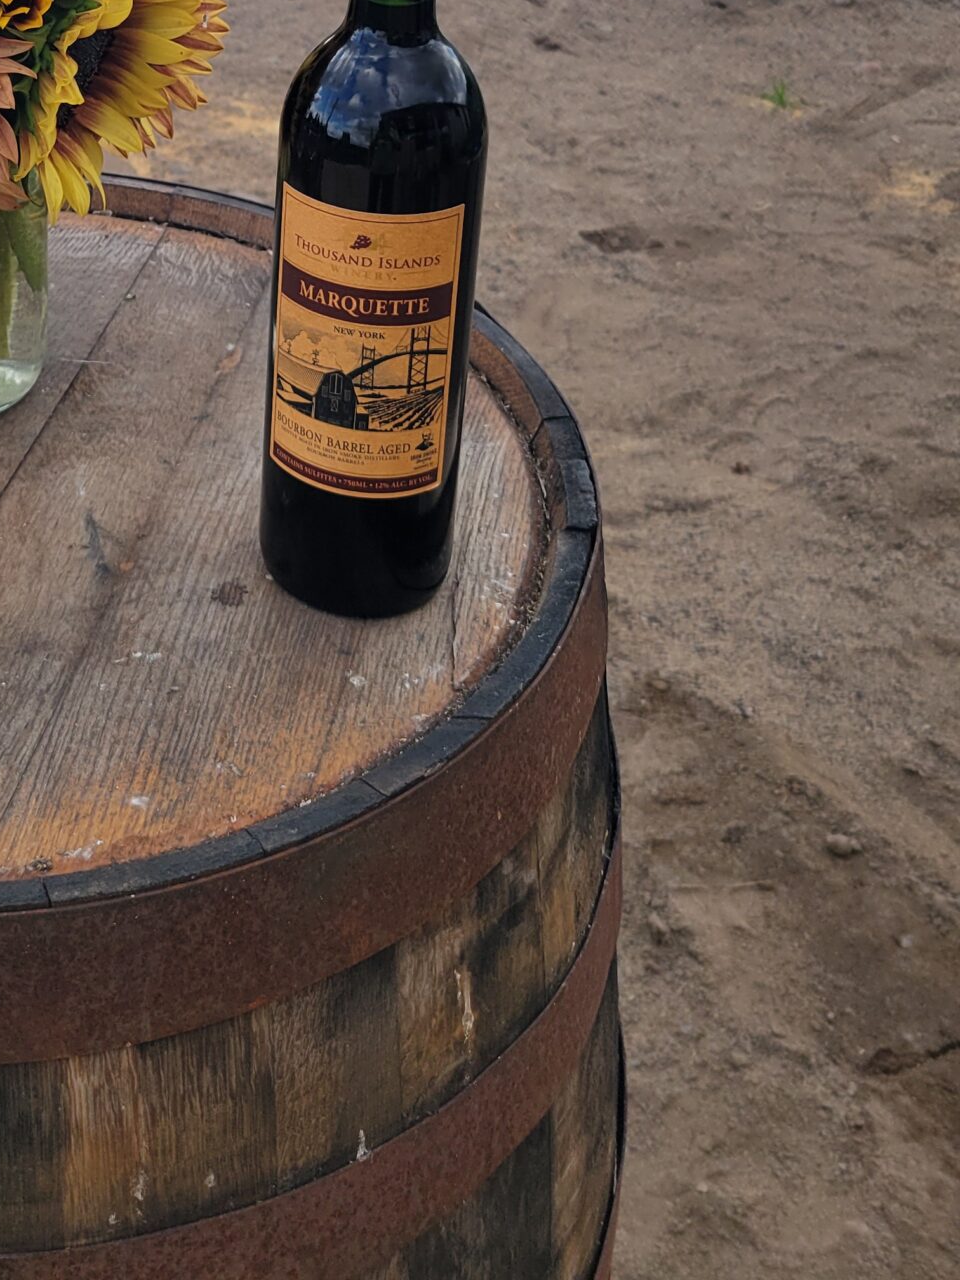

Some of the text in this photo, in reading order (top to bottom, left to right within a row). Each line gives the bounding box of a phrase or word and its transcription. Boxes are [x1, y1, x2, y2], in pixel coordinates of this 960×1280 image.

[295, 233, 441, 270] THOUSAND ISLANDS
[299, 279, 430, 318] MARQUETTE
[333, 325, 385, 340] NEW YORK
[276, 410, 322, 444] BOURBON
[327, 436, 374, 455] BARREL
[377, 442, 411, 455] AGED
